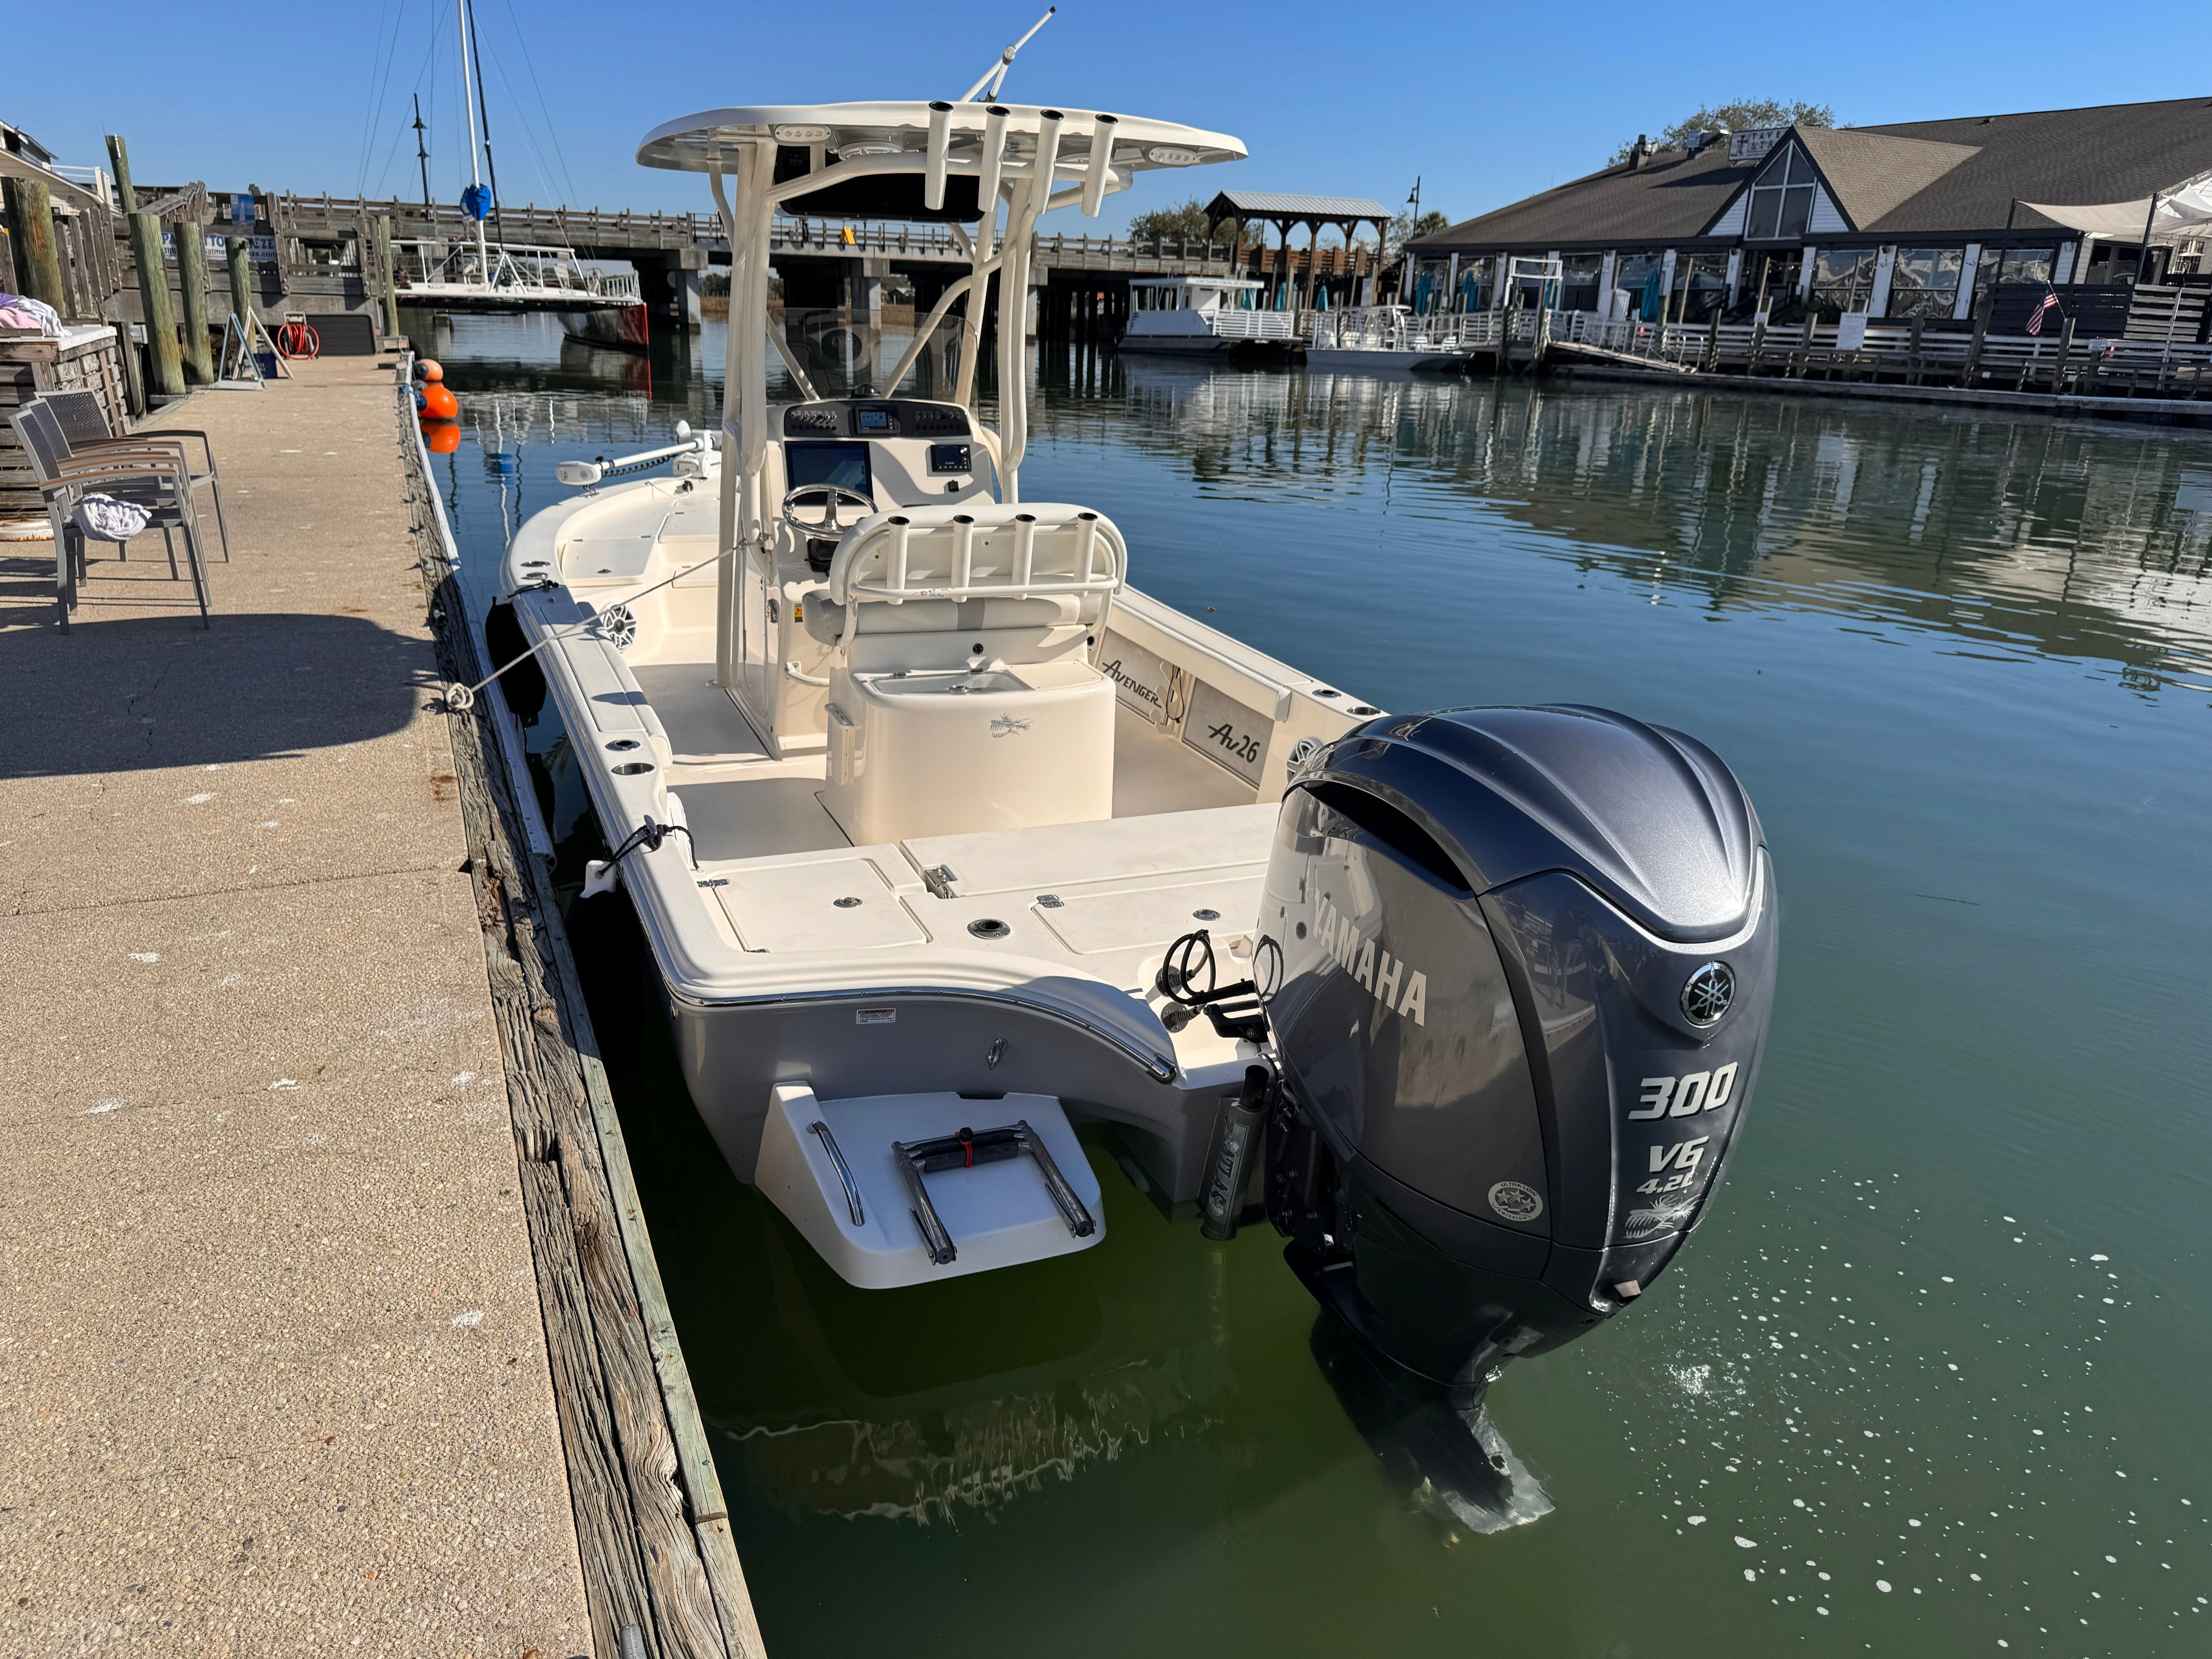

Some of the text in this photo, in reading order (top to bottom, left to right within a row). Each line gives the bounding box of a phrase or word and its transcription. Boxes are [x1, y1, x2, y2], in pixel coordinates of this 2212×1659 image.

[1752, 131, 1781, 140] TAVE
[1313, 888, 1427, 1027] YAMAHA
[1628, 1061, 1738, 1121] 300
[1649, 1135, 1709, 1173] V6
[1636, 1172, 1693, 1194] 4.2L
[1498, 1209, 1527, 1219] EMISSION
